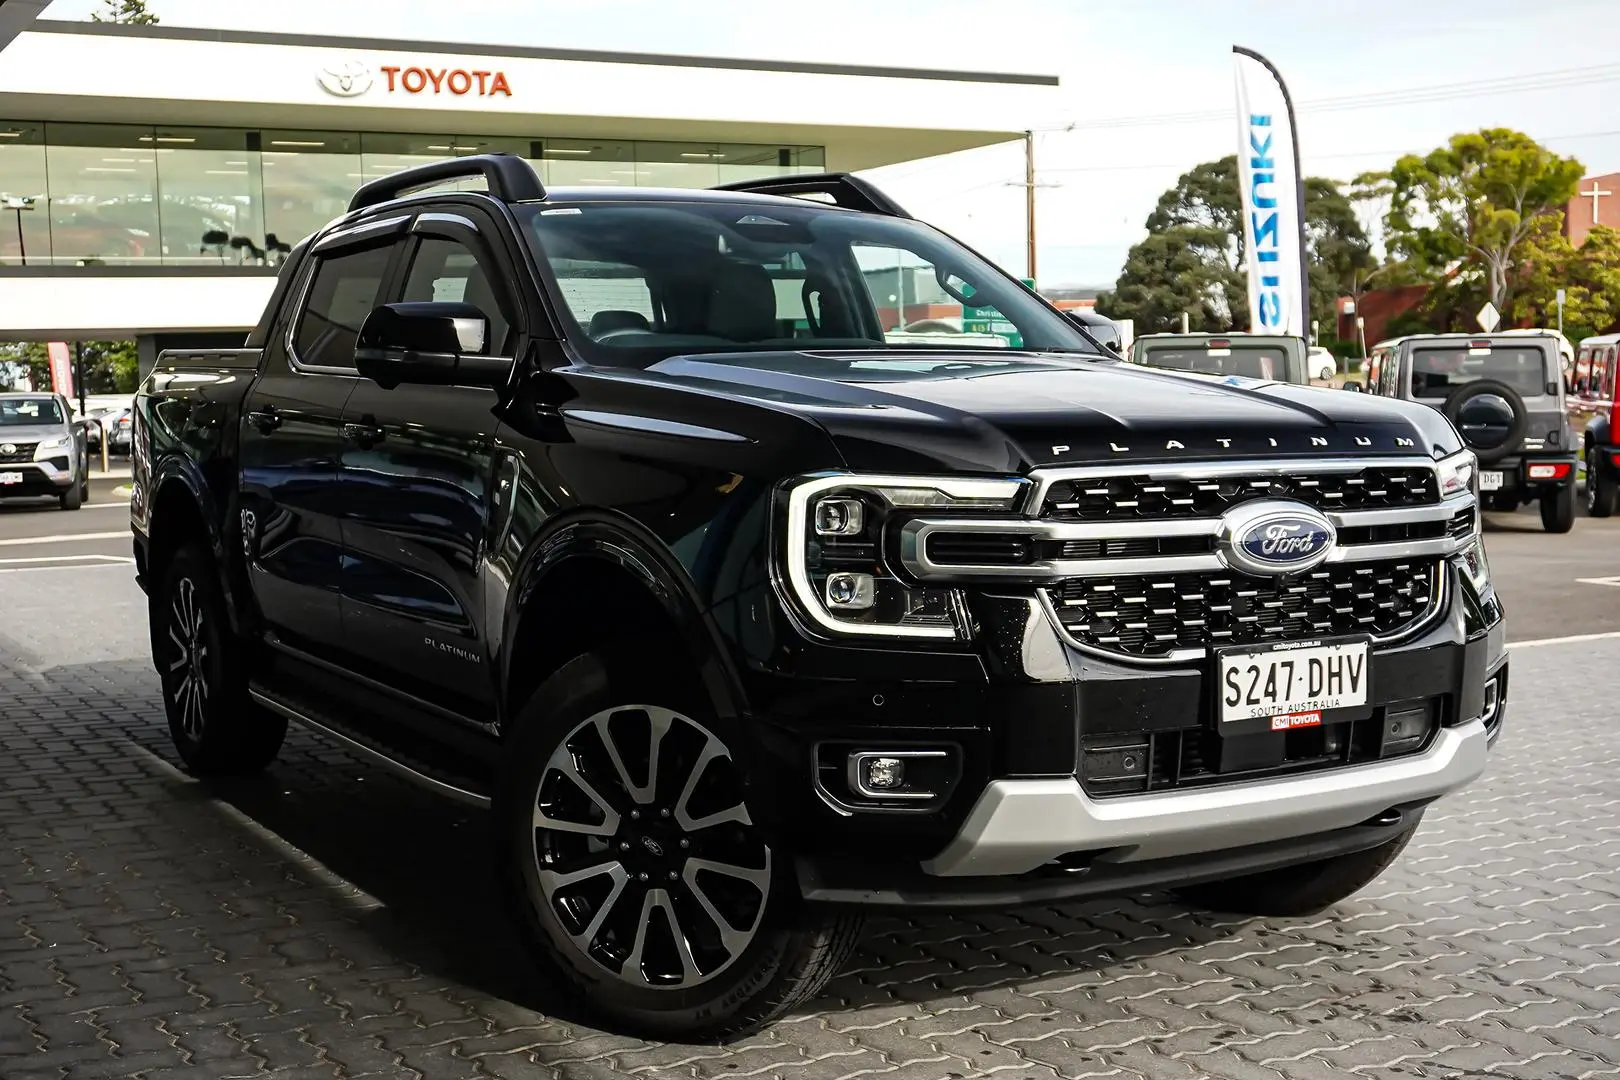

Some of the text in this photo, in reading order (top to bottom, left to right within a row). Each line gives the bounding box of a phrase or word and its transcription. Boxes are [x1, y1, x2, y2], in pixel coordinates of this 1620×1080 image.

[380, 66, 513, 97] TOYOTA
[1052, 436, 1415, 456] PLATINUM
[1261, 524, 1314, 555] Ford
[424, 637, 480, 663] PLATINUM
[1272, 640, 1321, 651] cmitoyota.com.au
[1250, 699, 1341, 718] SOUTH AUSTRALIA
[1274, 713, 1321, 727] CMI TOYOTA
